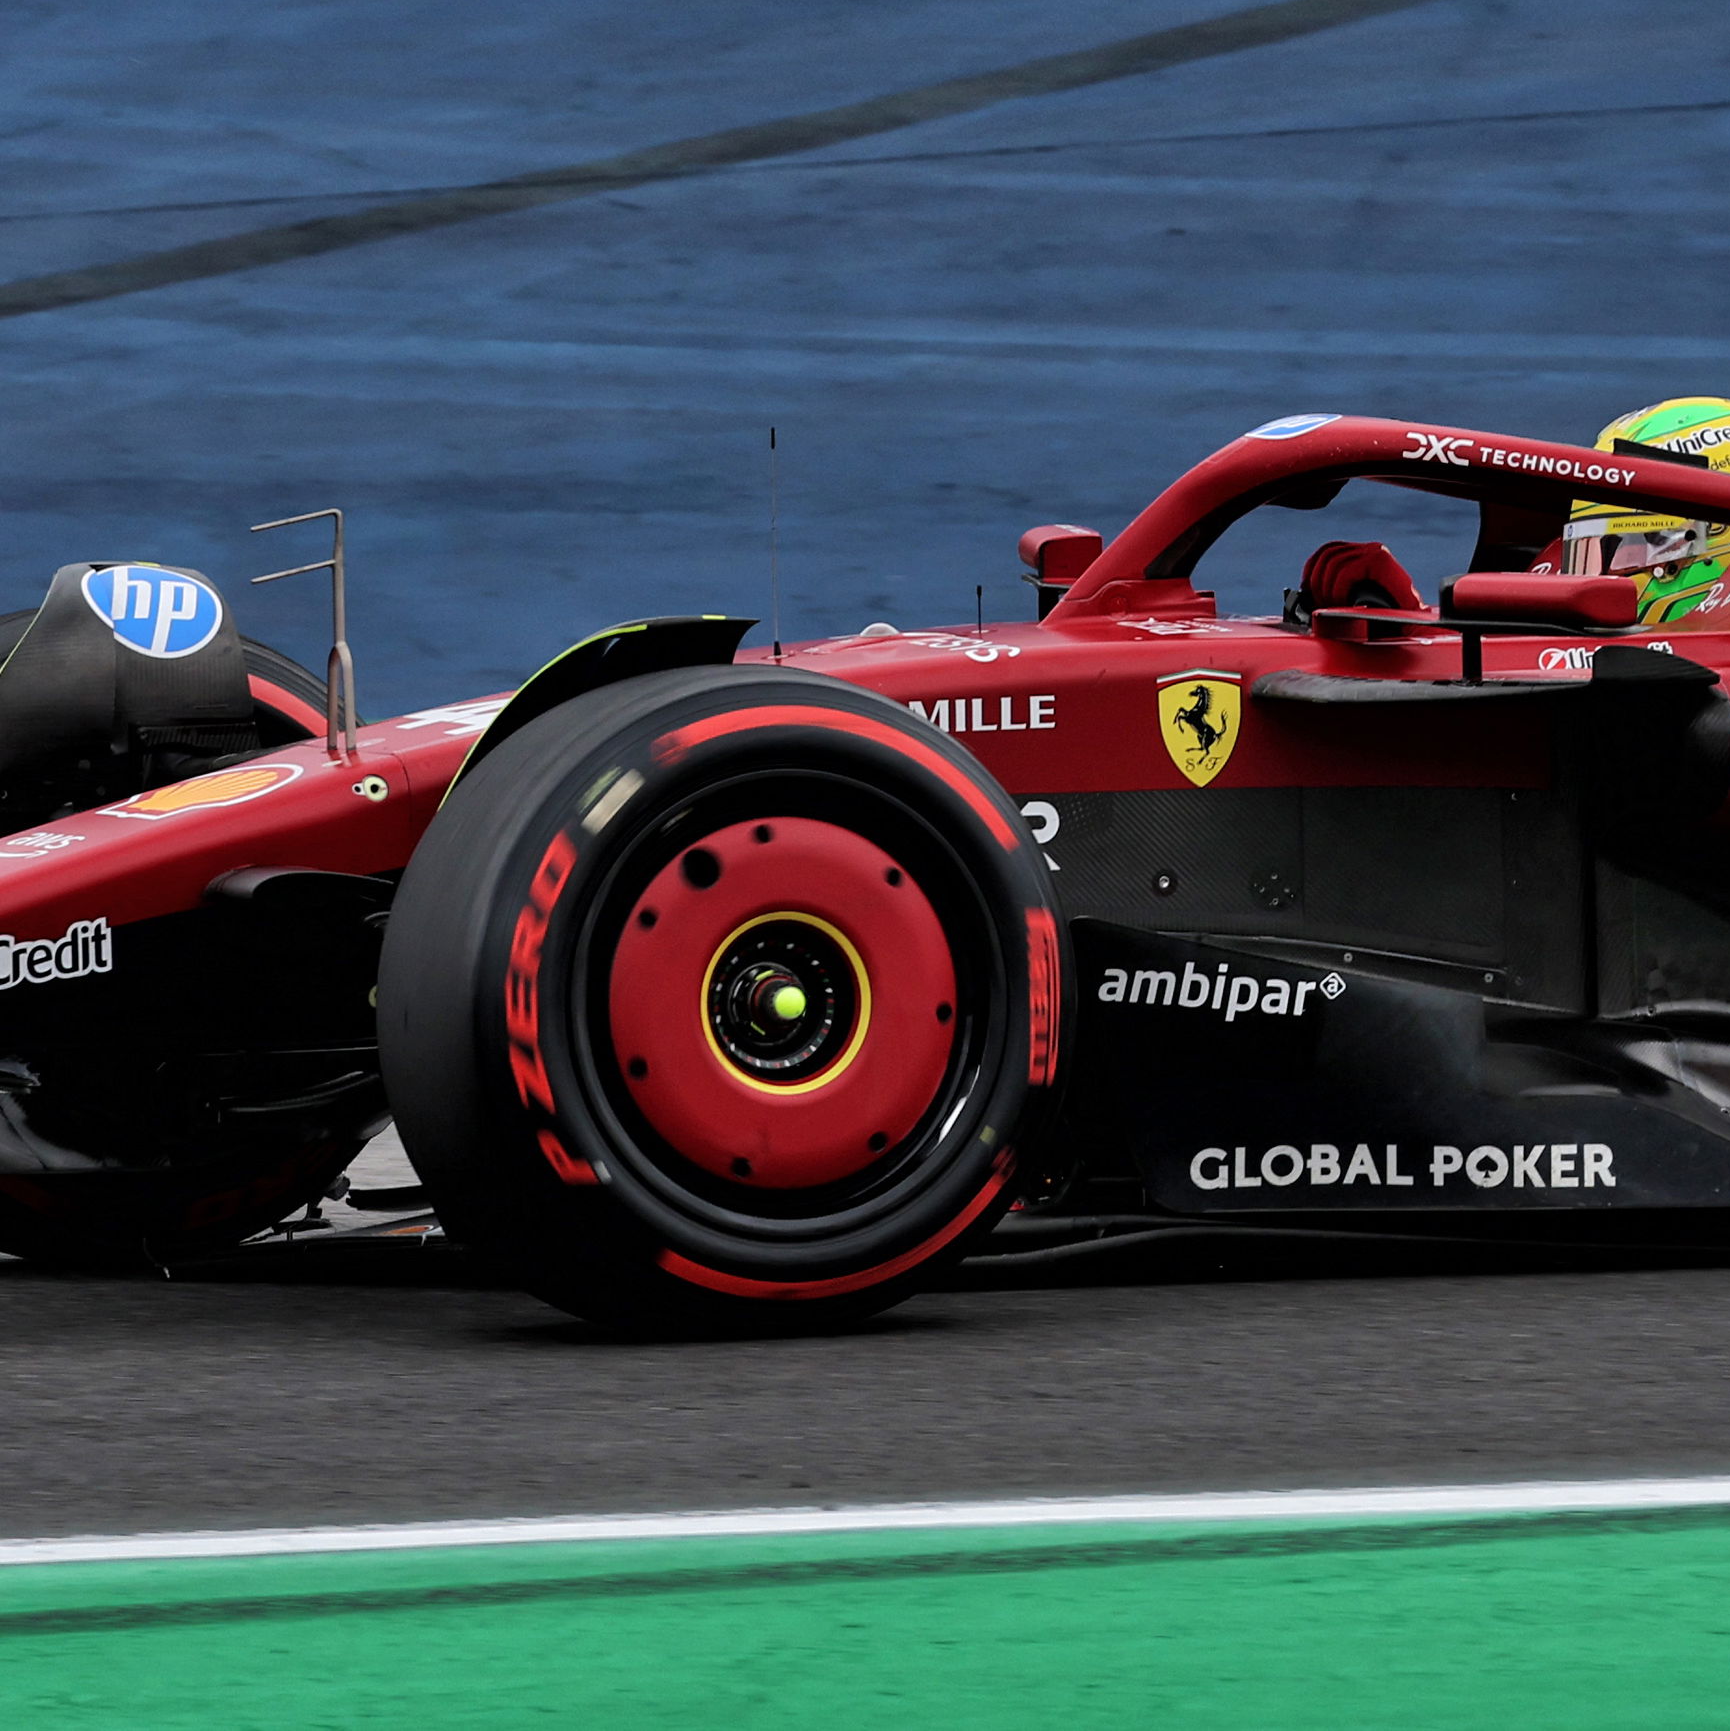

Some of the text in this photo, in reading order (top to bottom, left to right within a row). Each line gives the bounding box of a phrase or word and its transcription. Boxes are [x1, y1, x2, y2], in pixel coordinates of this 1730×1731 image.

[1402, 431, 1636, 486] DXC TECHNOLOGY
[111, 567, 198, 653] hp
[908, 694, 1056, 733] MILLE
[1098, 961, 1317, 1022] ambipar
[1189, 1142, 1617, 1190] GLOBAL POKER
